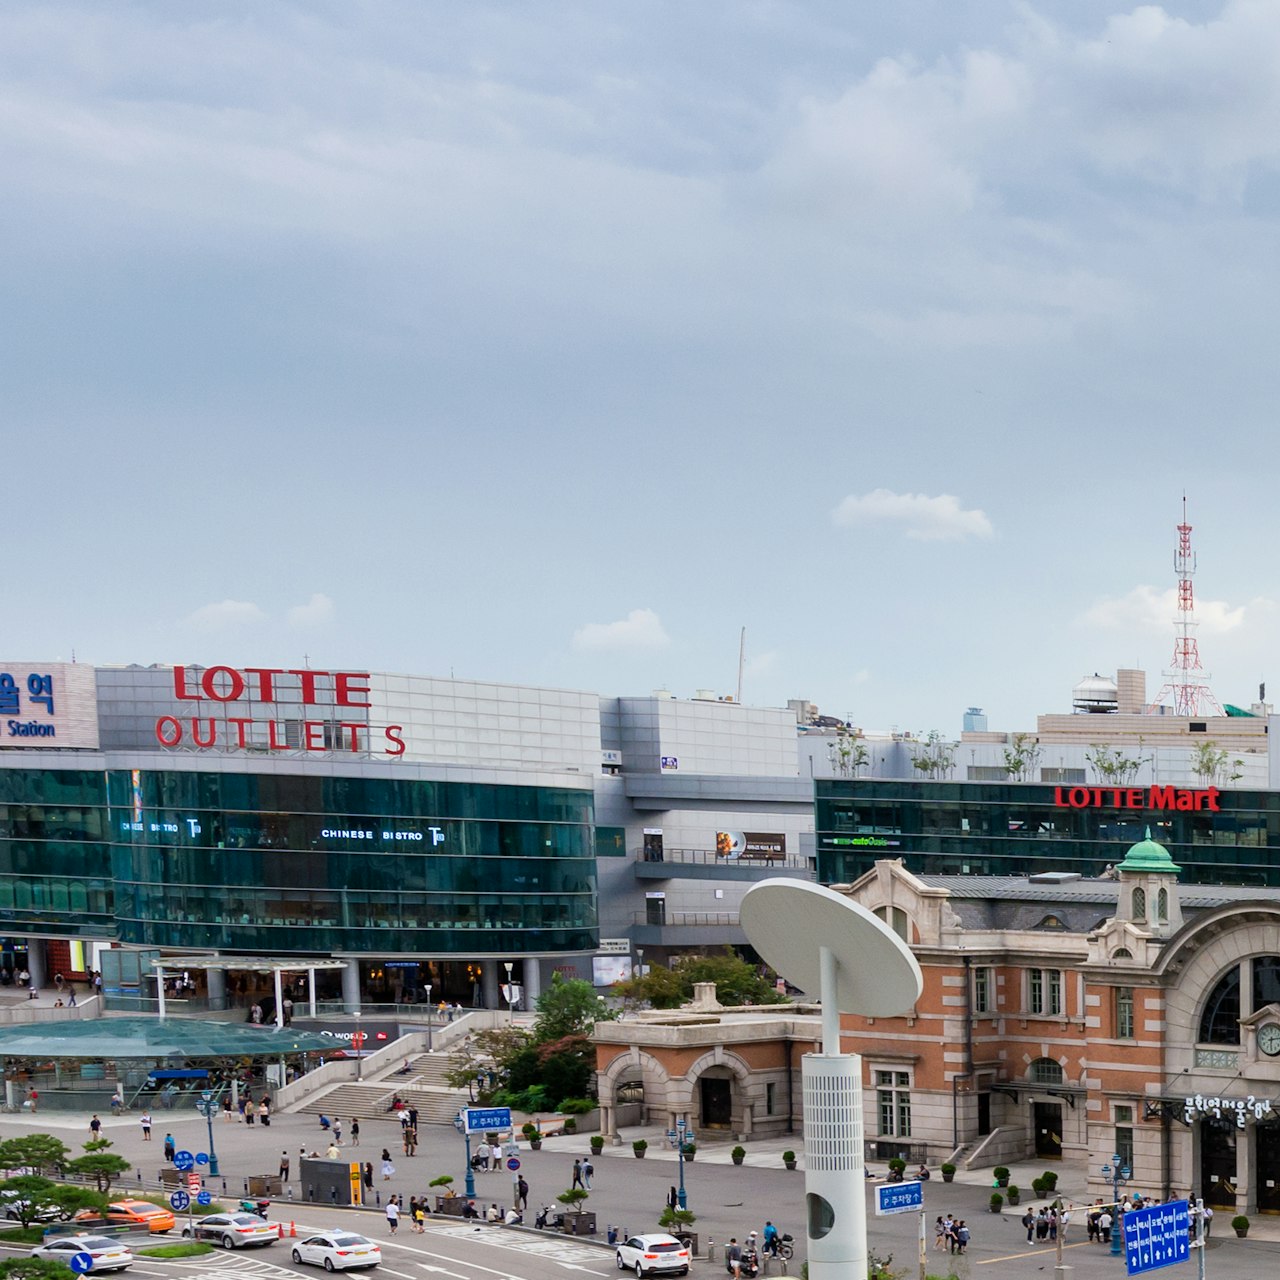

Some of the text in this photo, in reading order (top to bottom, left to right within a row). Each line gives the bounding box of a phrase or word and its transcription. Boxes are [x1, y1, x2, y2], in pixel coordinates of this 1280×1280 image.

[173, 665, 371, 708] LOTTE
[8, 720, 55, 737] Station
[155, 715, 406, 755] OUTLETS
[1054, 784, 1220, 812] LOTTE Mart
[321, 829, 373, 839] CHINESE
[382, 831, 423, 840] BISTRO
[480, 1117, 500, 1128] 주차장
[891, 1194, 912, 1205] 주차장
